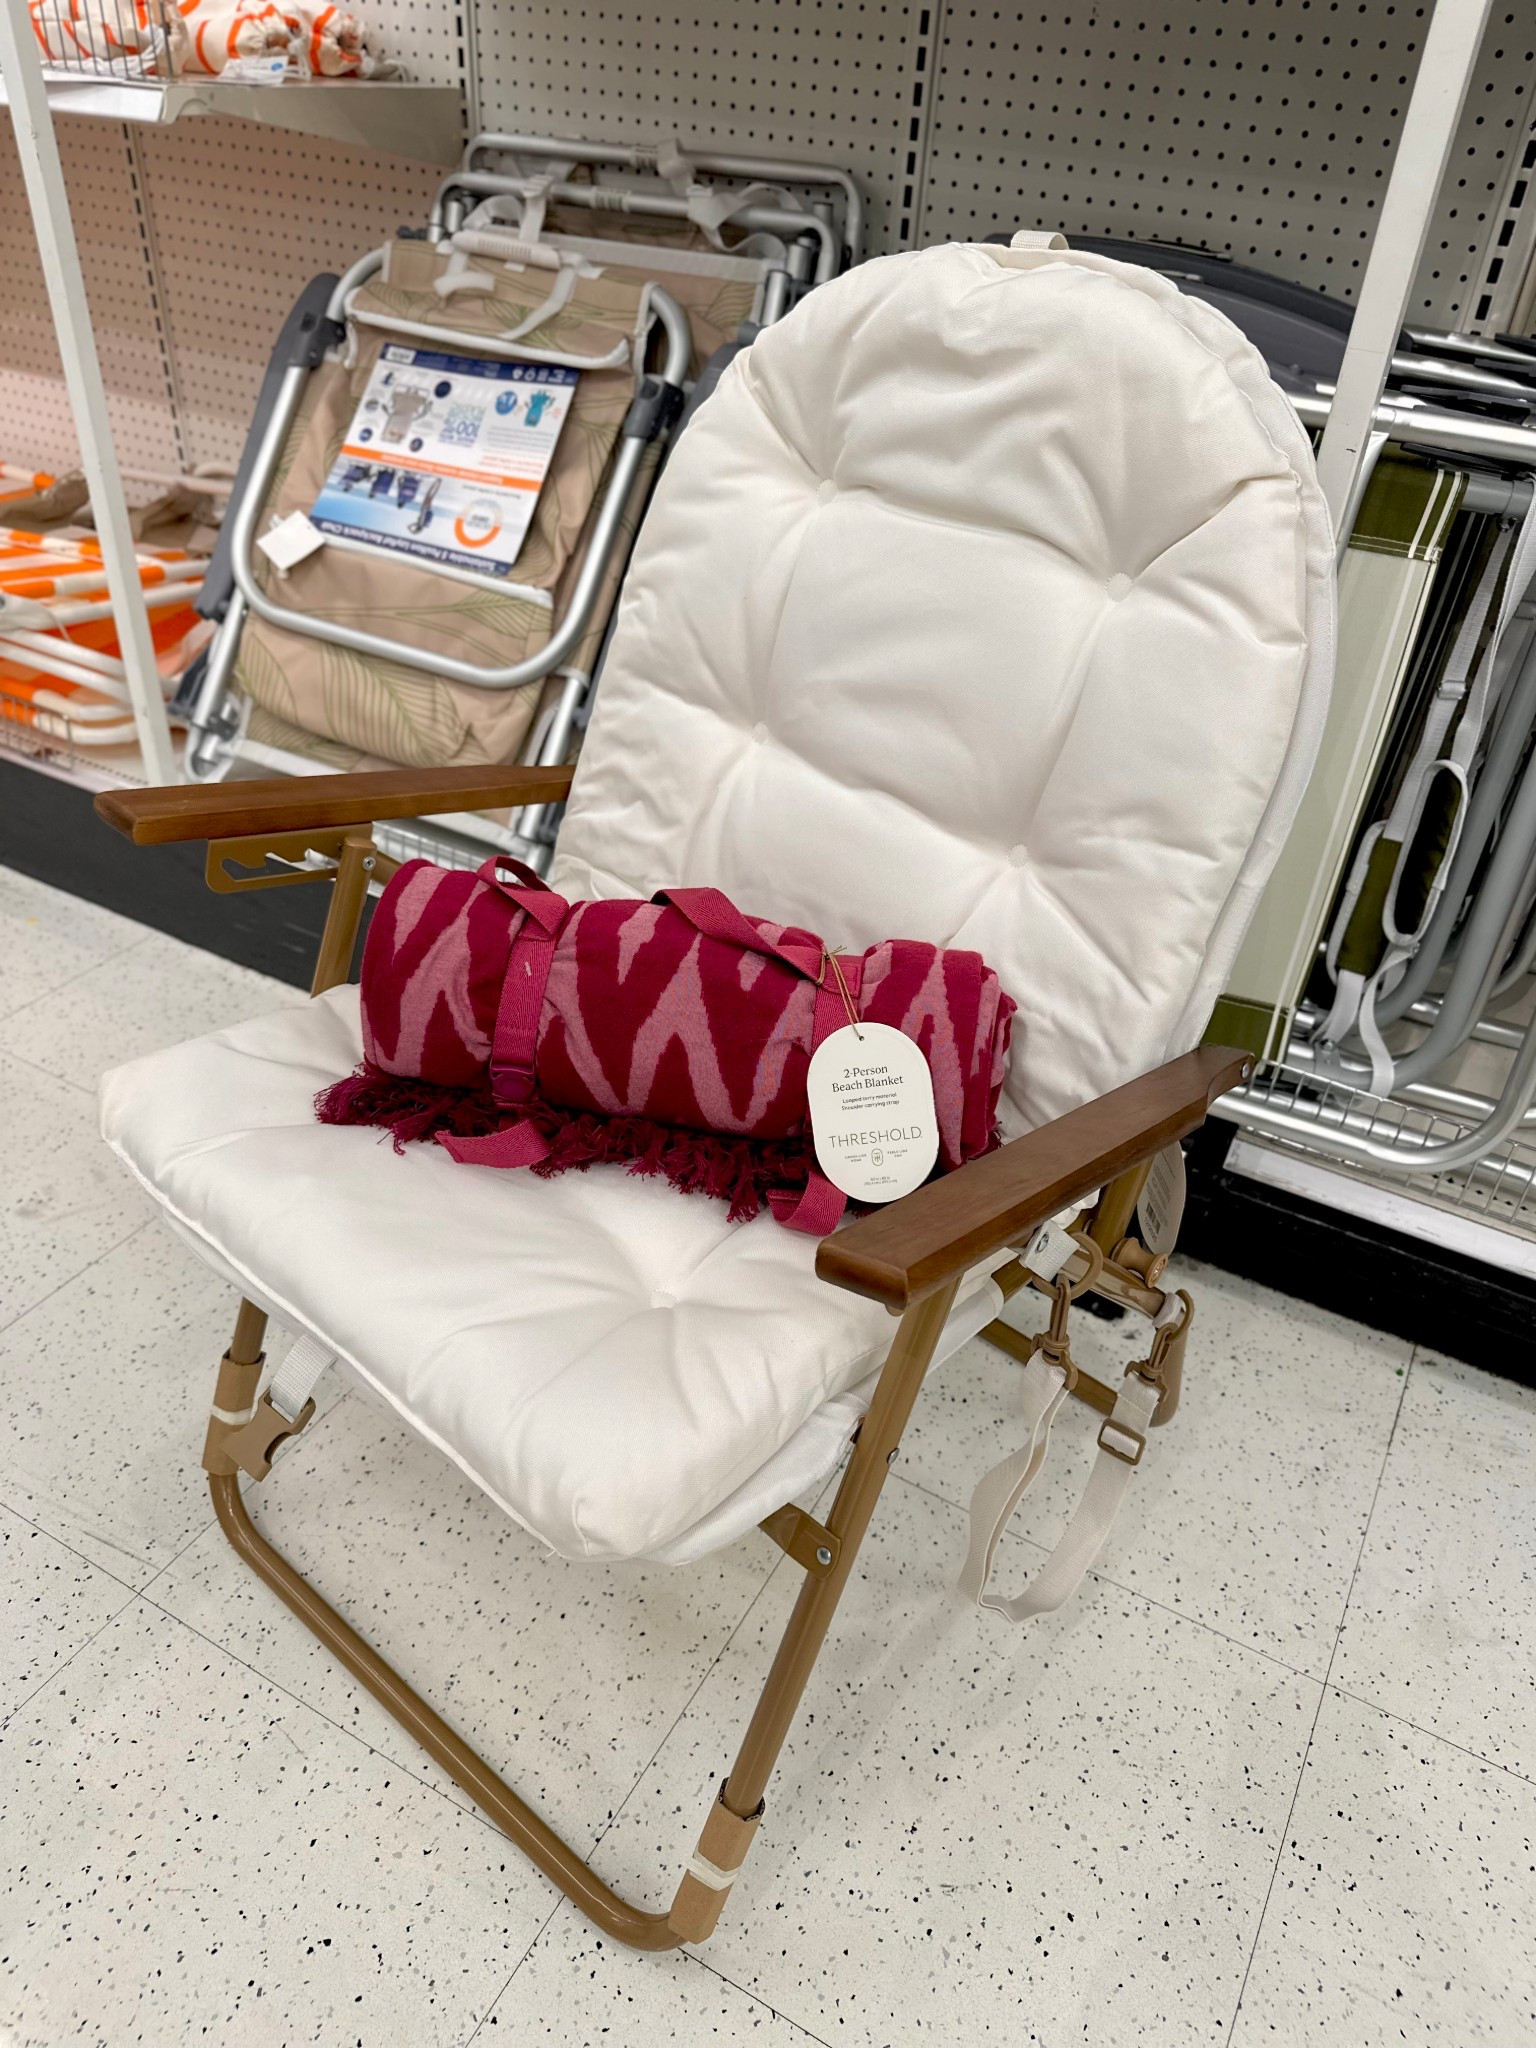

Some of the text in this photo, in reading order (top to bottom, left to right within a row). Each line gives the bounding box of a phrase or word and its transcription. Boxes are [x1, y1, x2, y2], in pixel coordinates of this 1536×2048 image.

[843, 1066, 888, 1079] 2-Person
[831, 1075, 904, 1093] Beach Blanket
[828, 1126, 922, 1148] THRESHOLD
